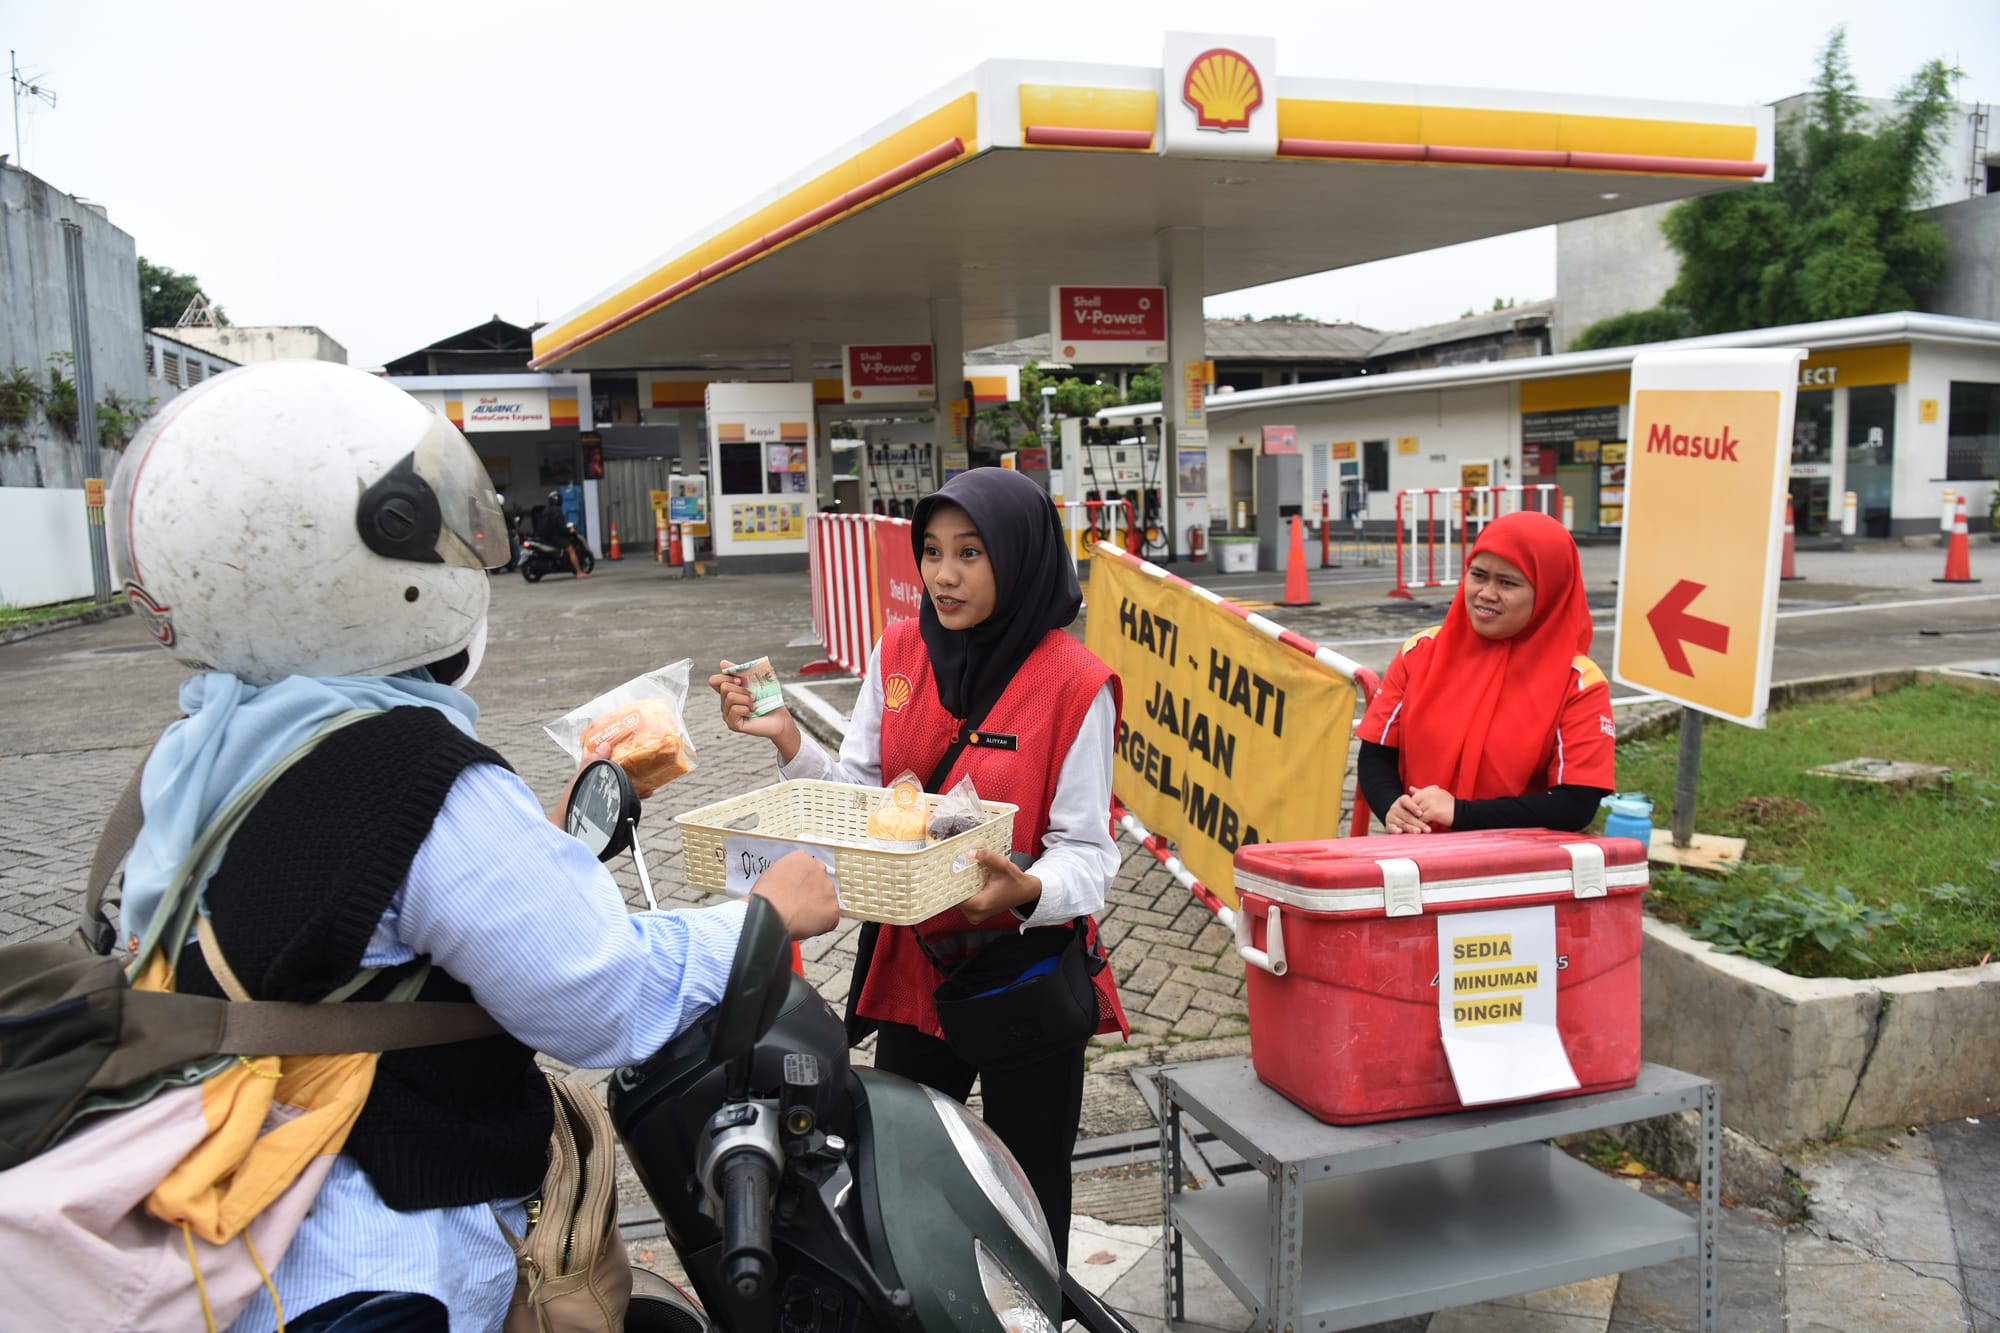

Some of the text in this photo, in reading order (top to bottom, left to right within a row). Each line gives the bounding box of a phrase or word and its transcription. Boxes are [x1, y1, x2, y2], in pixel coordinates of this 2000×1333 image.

[1073, 295, 1101, 307] Shell
[1073, 309, 1145, 325] V-Power
[860, 351, 882, 361] Shell
[860, 362, 917, 374] V-Power
[750, 427, 775, 437] Kasir
[1647, 423, 1740, 463] Masuk
[1119, 596, 1179, 668] HATI
[1208, 647, 1286, 739] HATI
[1453, 940, 1512, 959] SEDIA
[1453, 970, 1538, 991] MINUMAN
[1453, 1001, 1522, 1022] DINGIN
